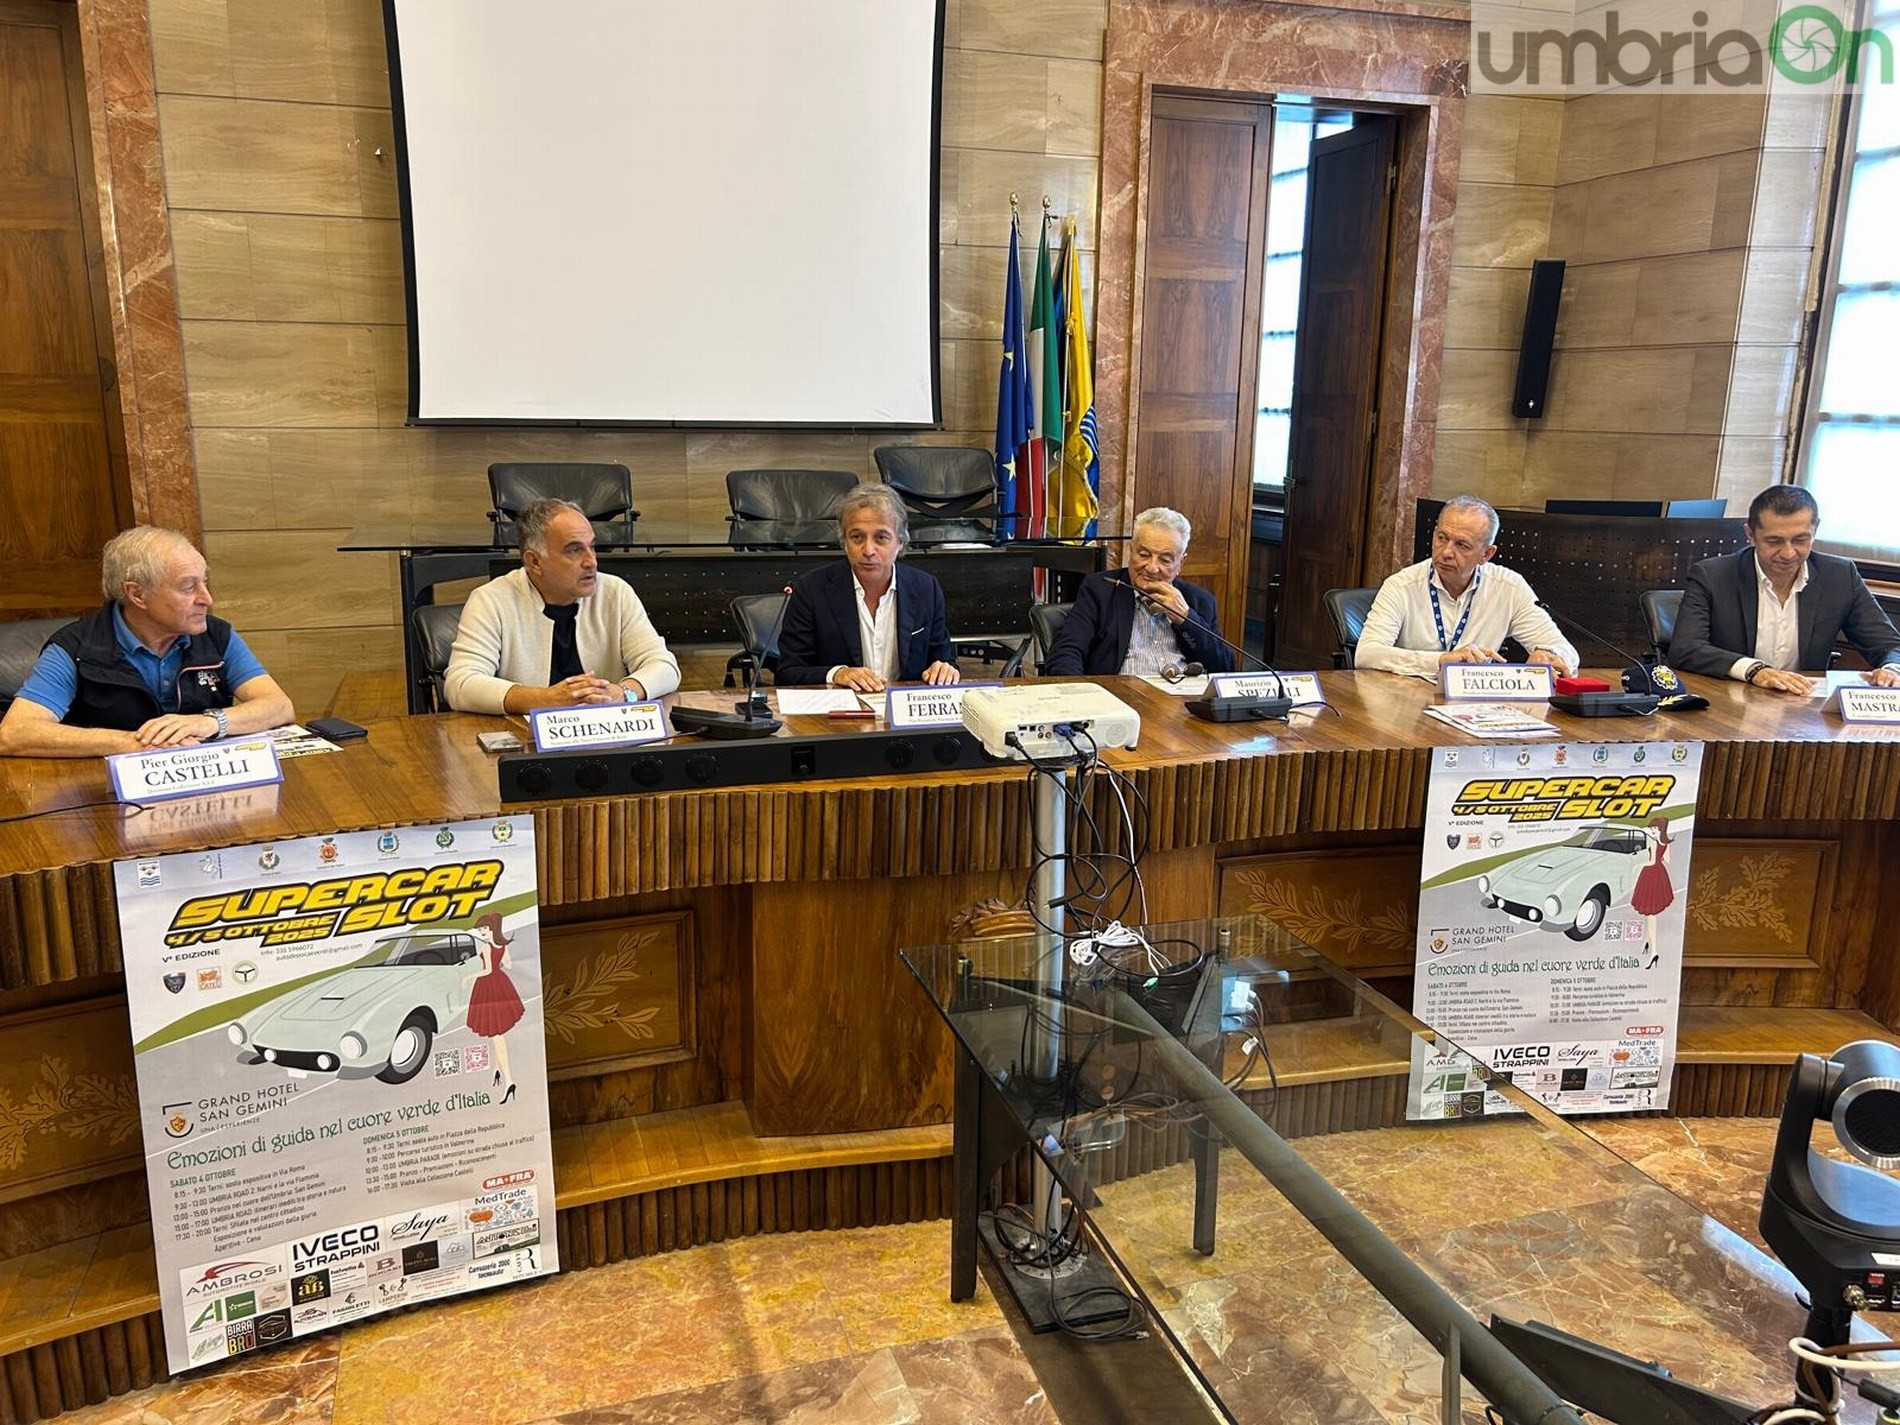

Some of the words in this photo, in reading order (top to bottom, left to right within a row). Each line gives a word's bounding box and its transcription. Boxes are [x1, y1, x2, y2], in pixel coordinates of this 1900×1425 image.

[1462, 668, 1504, 677] Francesco
[1235, 679, 1271, 687] Maurizio
[1238, 687, 1300, 697] SPEZILI
[1463, 678, 1535, 690] FALCIOLA
[907, 693, 951, 701] Francesco
[1849, 691, 1896, 700] Francesco
[546, 714, 580, 725] Marco
[549, 718, 656, 740] SCHENARDI
[141, 759, 166, 769] Pier
[171, 751, 219, 765] Giorgio
[145, 759, 249, 786] CASTELLI
[1456, 776, 1675, 800] SUPERCAR
[1487, 803, 1557, 812] OTTOBRE
[1557, 798, 1663, 818] SLOT
[175, 862, 502, 929] SUPERCAR
[337, 888, 492, 933] SLOT
[224, 912, 336, 939] OTTOBRE
[264, 926, 329, 944] 2025
[1452, 927, 1484, 935] GRAND
[1488, 925, 1515, 933] HOTEL
[1473, 935, 1506, 943] GEMINI
[174, 948, 220, 961] EDIZIONE
[1428, 961, 1476, 975] Emozioni
[1479, 961, 1488, 973] di
[1490, 959, 1520, 976] guida
[1522, 959, 1538, 973] nel
[1540, 960, 1572, 971] cuore
[1576, 957, 1604, 970] verde
[1608, 956, 1640, 969] d'Italia
[1492, 1058, 1549, 1068] STRAPPINI
[1493, 1046, 1550, 1060] IVECO
[198, 1090, 250, 1110] GRAND
[257, 1081, 299, 1099] HOTEL
[199, 1108, 229, 1123] SAN
[235, 1096, 287, 1116] GEMINI
[167, 1140, 247, 1169] Emozioni
[251, 1134, 266, 1153] di
[270, 1124, 315, 1153] guida
[319, 1117, 342, 1139] nel
[346, 1109, 392, 1133] cuore
[396, 1097, 441, 1122] verde
[445, 1087, 490, 1112] d'Italia
[362, 1131, 394, 1144] DOMENICA
[401, 1124, 428, 1136] OTTOBRE
[169, 1175, 196, 1189] SABATO
[205, 1167, 236, 1181] OTTOBRE
[474, 1186, 526, 1206] MedTrade
[390, 1212, 449, 1242] Saya
[292, 1223, 378, 1260] IVECO
[294, 1241, 380, 1272] STRAPPINI
[185, 1264, 282, 1296] AMBROSI
[226, 1319, 253, 1336] BIRRA
